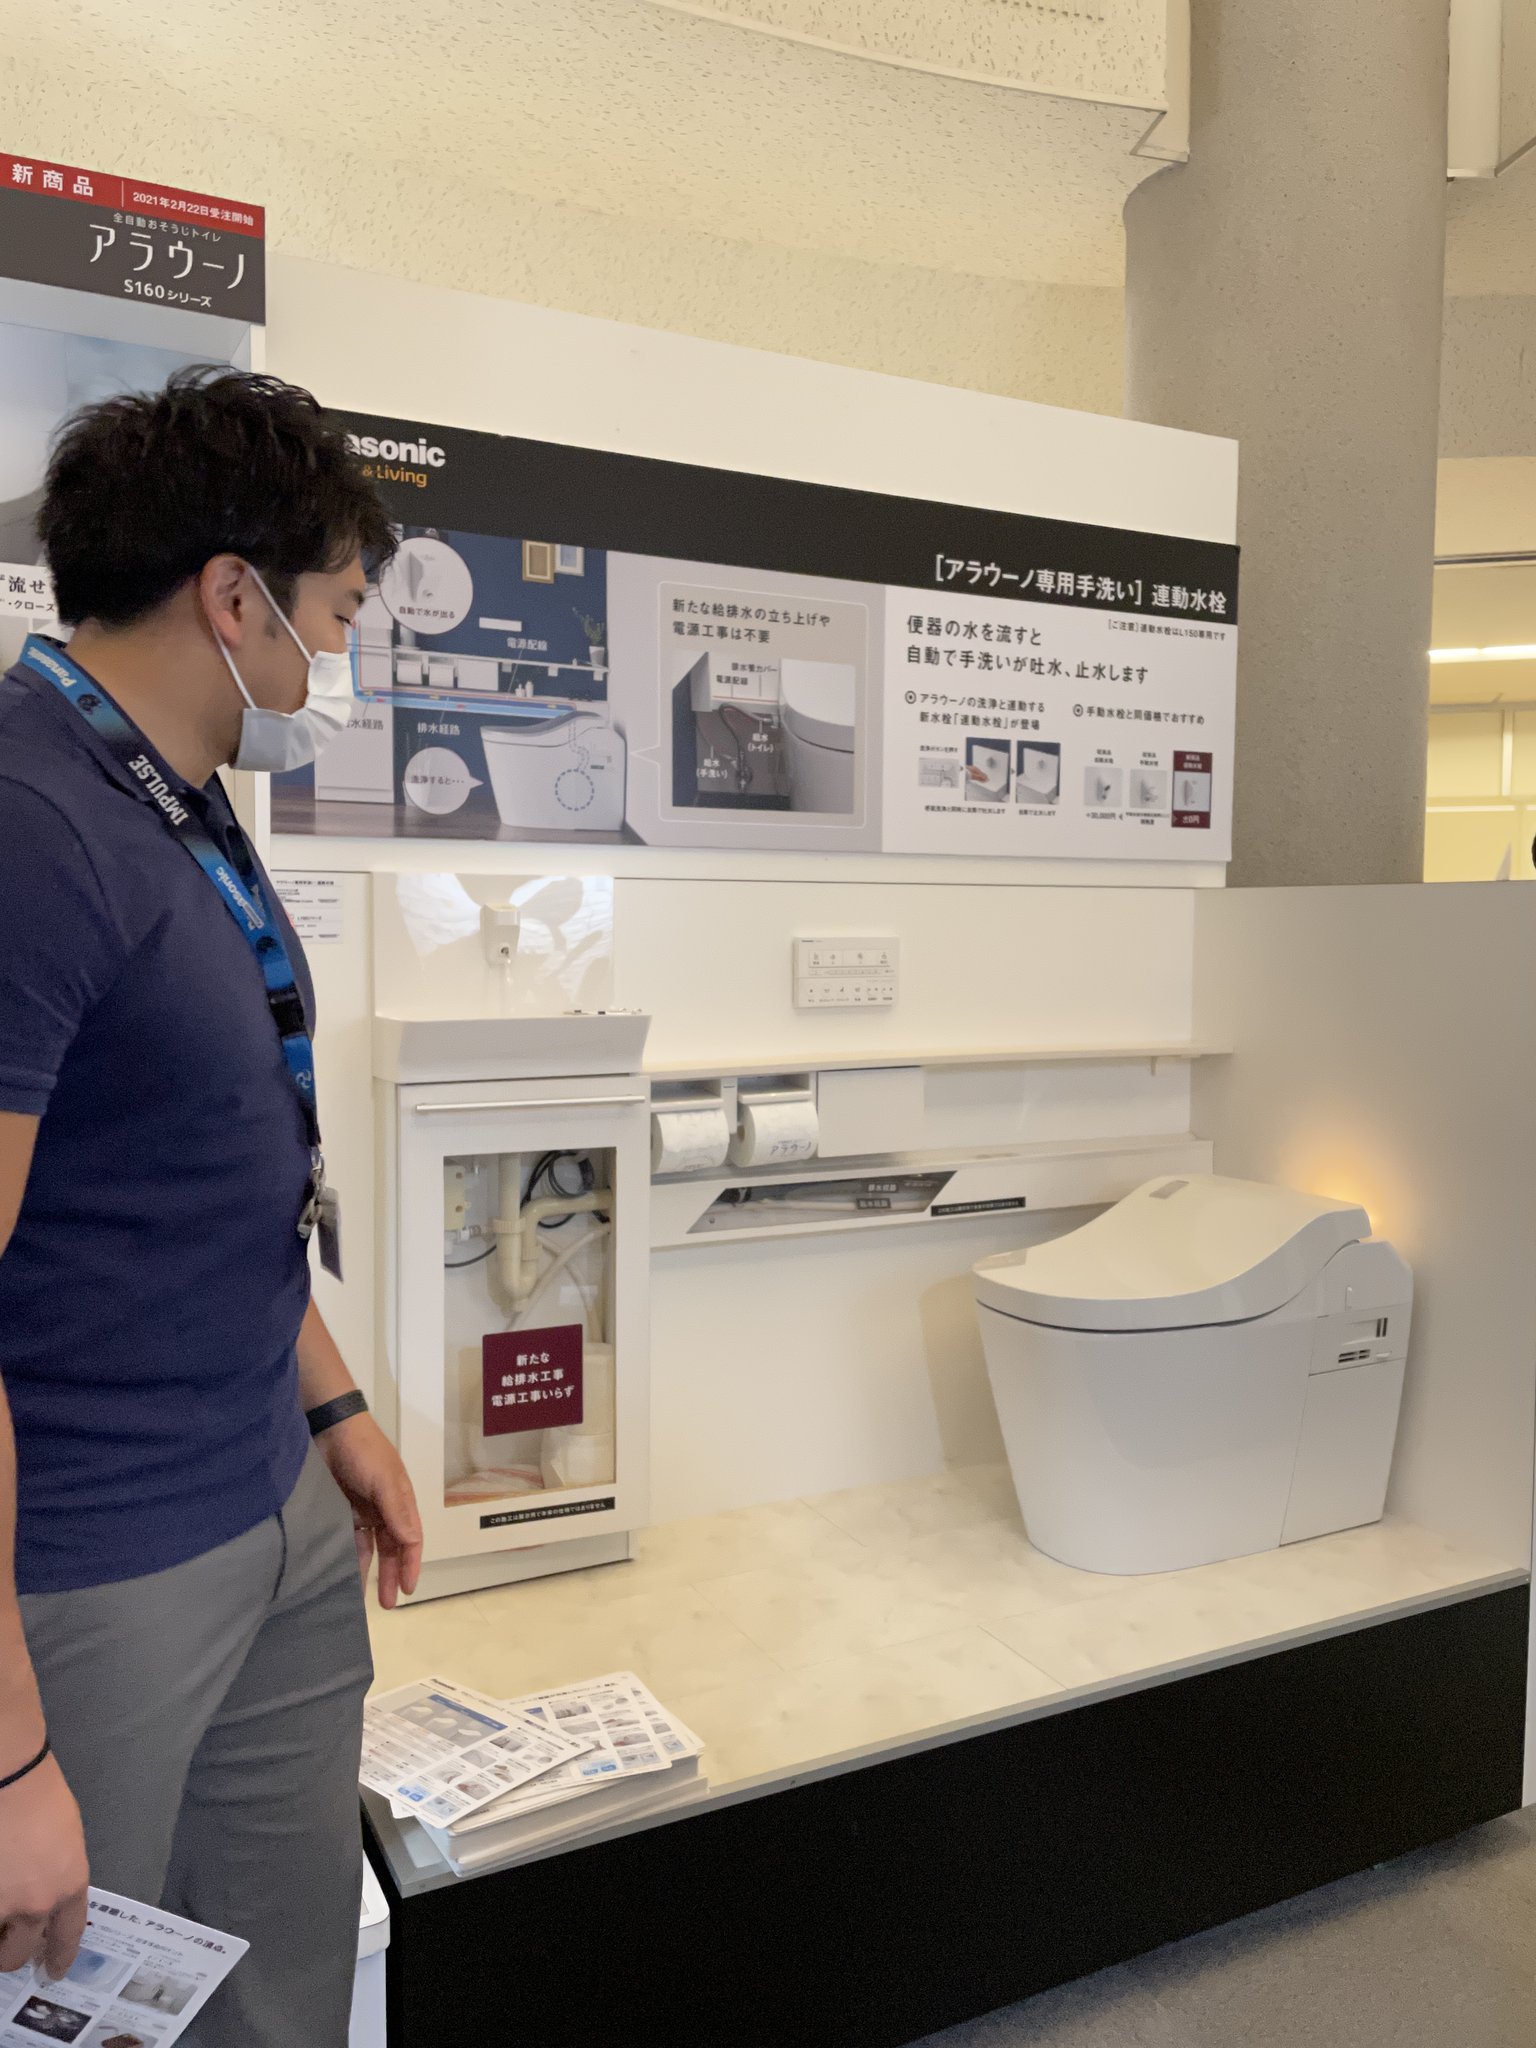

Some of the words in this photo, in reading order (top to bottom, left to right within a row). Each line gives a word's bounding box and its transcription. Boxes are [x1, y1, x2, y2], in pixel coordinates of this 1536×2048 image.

[12, 163, 94, 197] 新商品
[132, 190, 254, 227] 2021年2月22日受注開始
[113, 212, 221, 242] 全自動おそうじトイレ
[89, 223, 245, 290] アラウーノ
[123, 279, 213, 308] S160シリーズ
[344, 433, 446, 468] asonic
[376, 463, 428, 488] Living
[672, 598, 831, 628] 新たな給排水の立ち上げや
[1151, 583, 1227, 615] 連動水栓
[672, 621, 771, 643] 電源工事は不要
[906, 614, 1042, 646] 便器の水を流すと
[906, 644, 1149, 685] 自動で手洗いが吐水、止水します
[346, 718, 384, 730] 水経路
[127, 753, 189, 827] IMPULSE
[215, 866, 265, 931] Pasonic
[516, 1352, 550, 1367] 新たな
[501, 1368, 564, 1387] 給排水工事
[491, 1384, 575, 1407] 電源工事いらず
